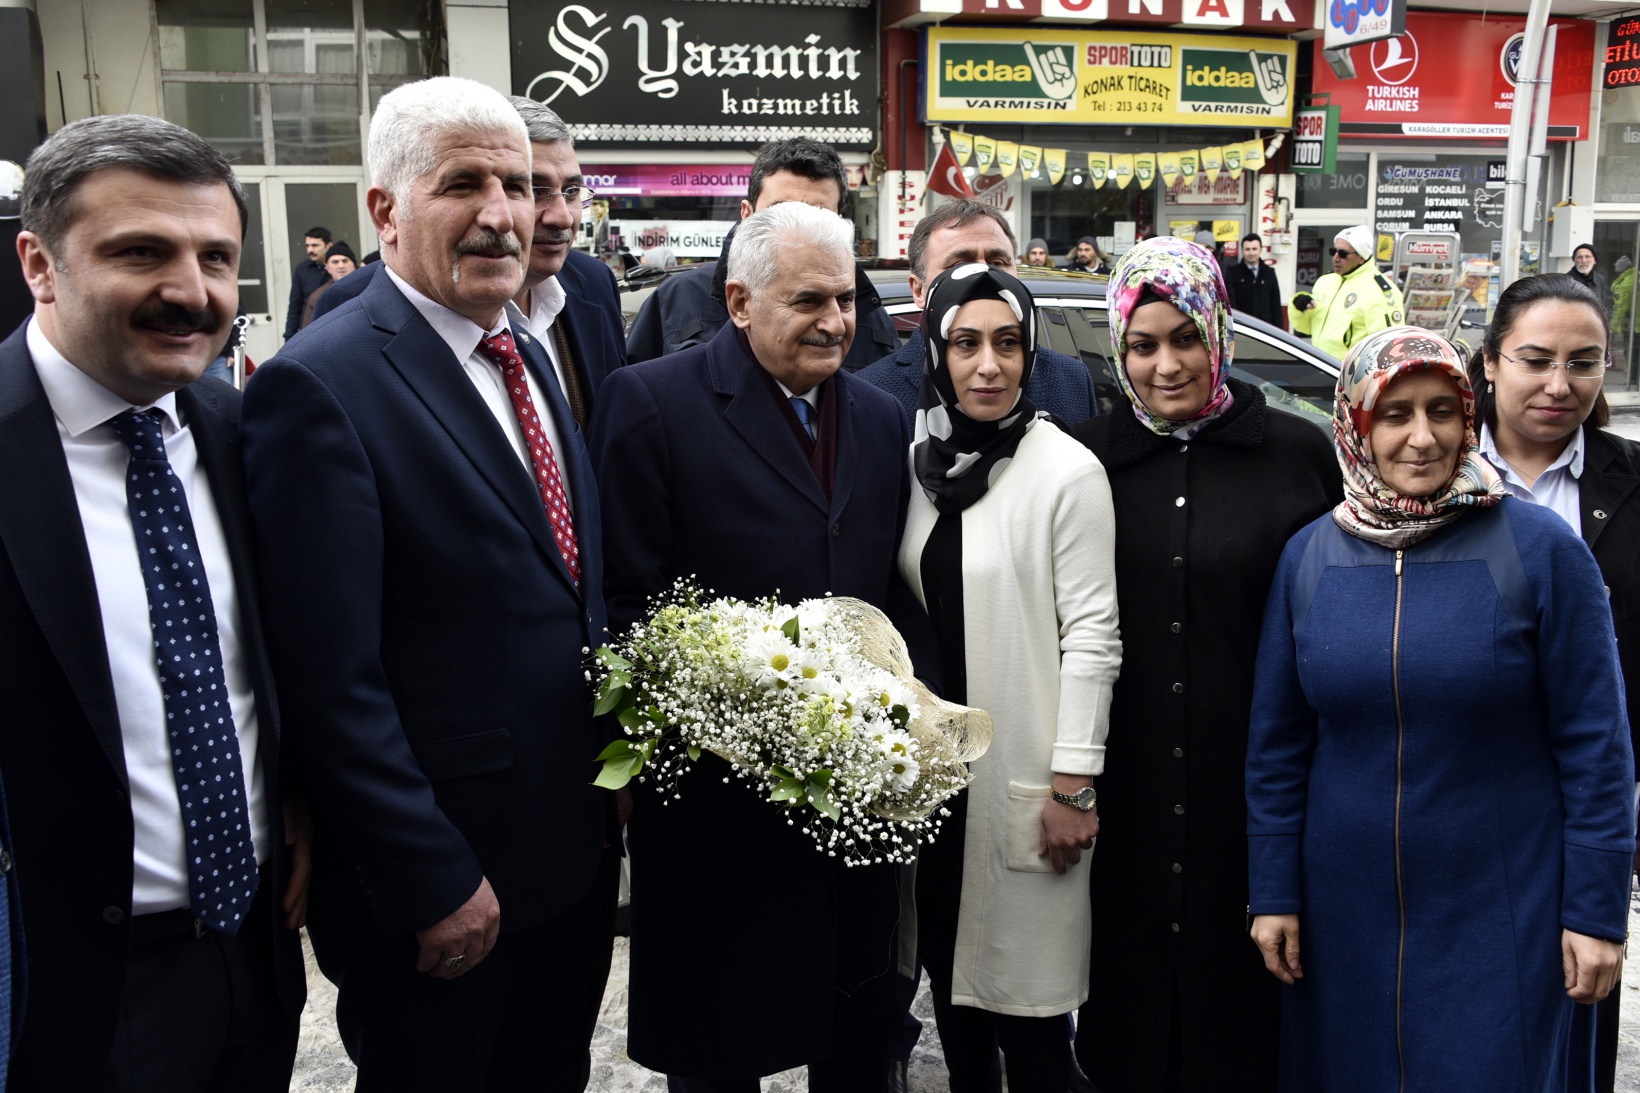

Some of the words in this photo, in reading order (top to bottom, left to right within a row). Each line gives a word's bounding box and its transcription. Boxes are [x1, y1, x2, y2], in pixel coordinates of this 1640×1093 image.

[1360, 19, 1388, 35] 6/49
[622, 14, 861, 98] Yasmin
[945, 59, 1032, 82] iddaa
[1186, 65, 1256, 88] iddaa
[1083, 75, 1124, 99] KONAK
[1128, 72, 1171, 100] TİCARET
[1366, 85, 1419, 99] TURKISH
[721, 87, 861, 116] kozmetik
[966, 99, 1068, 110] VARMISIN
[1092, 101, 1106, 112] Tel
[1116, 101, 1133, 112] 213
[1136, 102, 1149, 112] 43
[1151, 102, 1163, 113] 74
[1365, 99, 1419, 112] AIRLINES
[1191, 103, 1272, 115] VARMISIN
[1295, 116, 1323, 137] SPOR
[1295, 142, 1321, 164] TOTO
[670, 172, 687, 186] all
[691, 172, 734, 186] about
[1377, 182, 1419, 194] GİRESUN
[1425, 184, 1466, 194] KOCAELİ
[1377, 197, 1404, 206] ORDU
[1424, 197, 1470, 207] İSTANBUL
[1376, 210, 1416, 218] SAMSUN
[1423, 211, 1463, 219] ANKARA
[1423, 223, 1455, 232] BURSA
[634, 232, 680, 247] İNDİRİM
